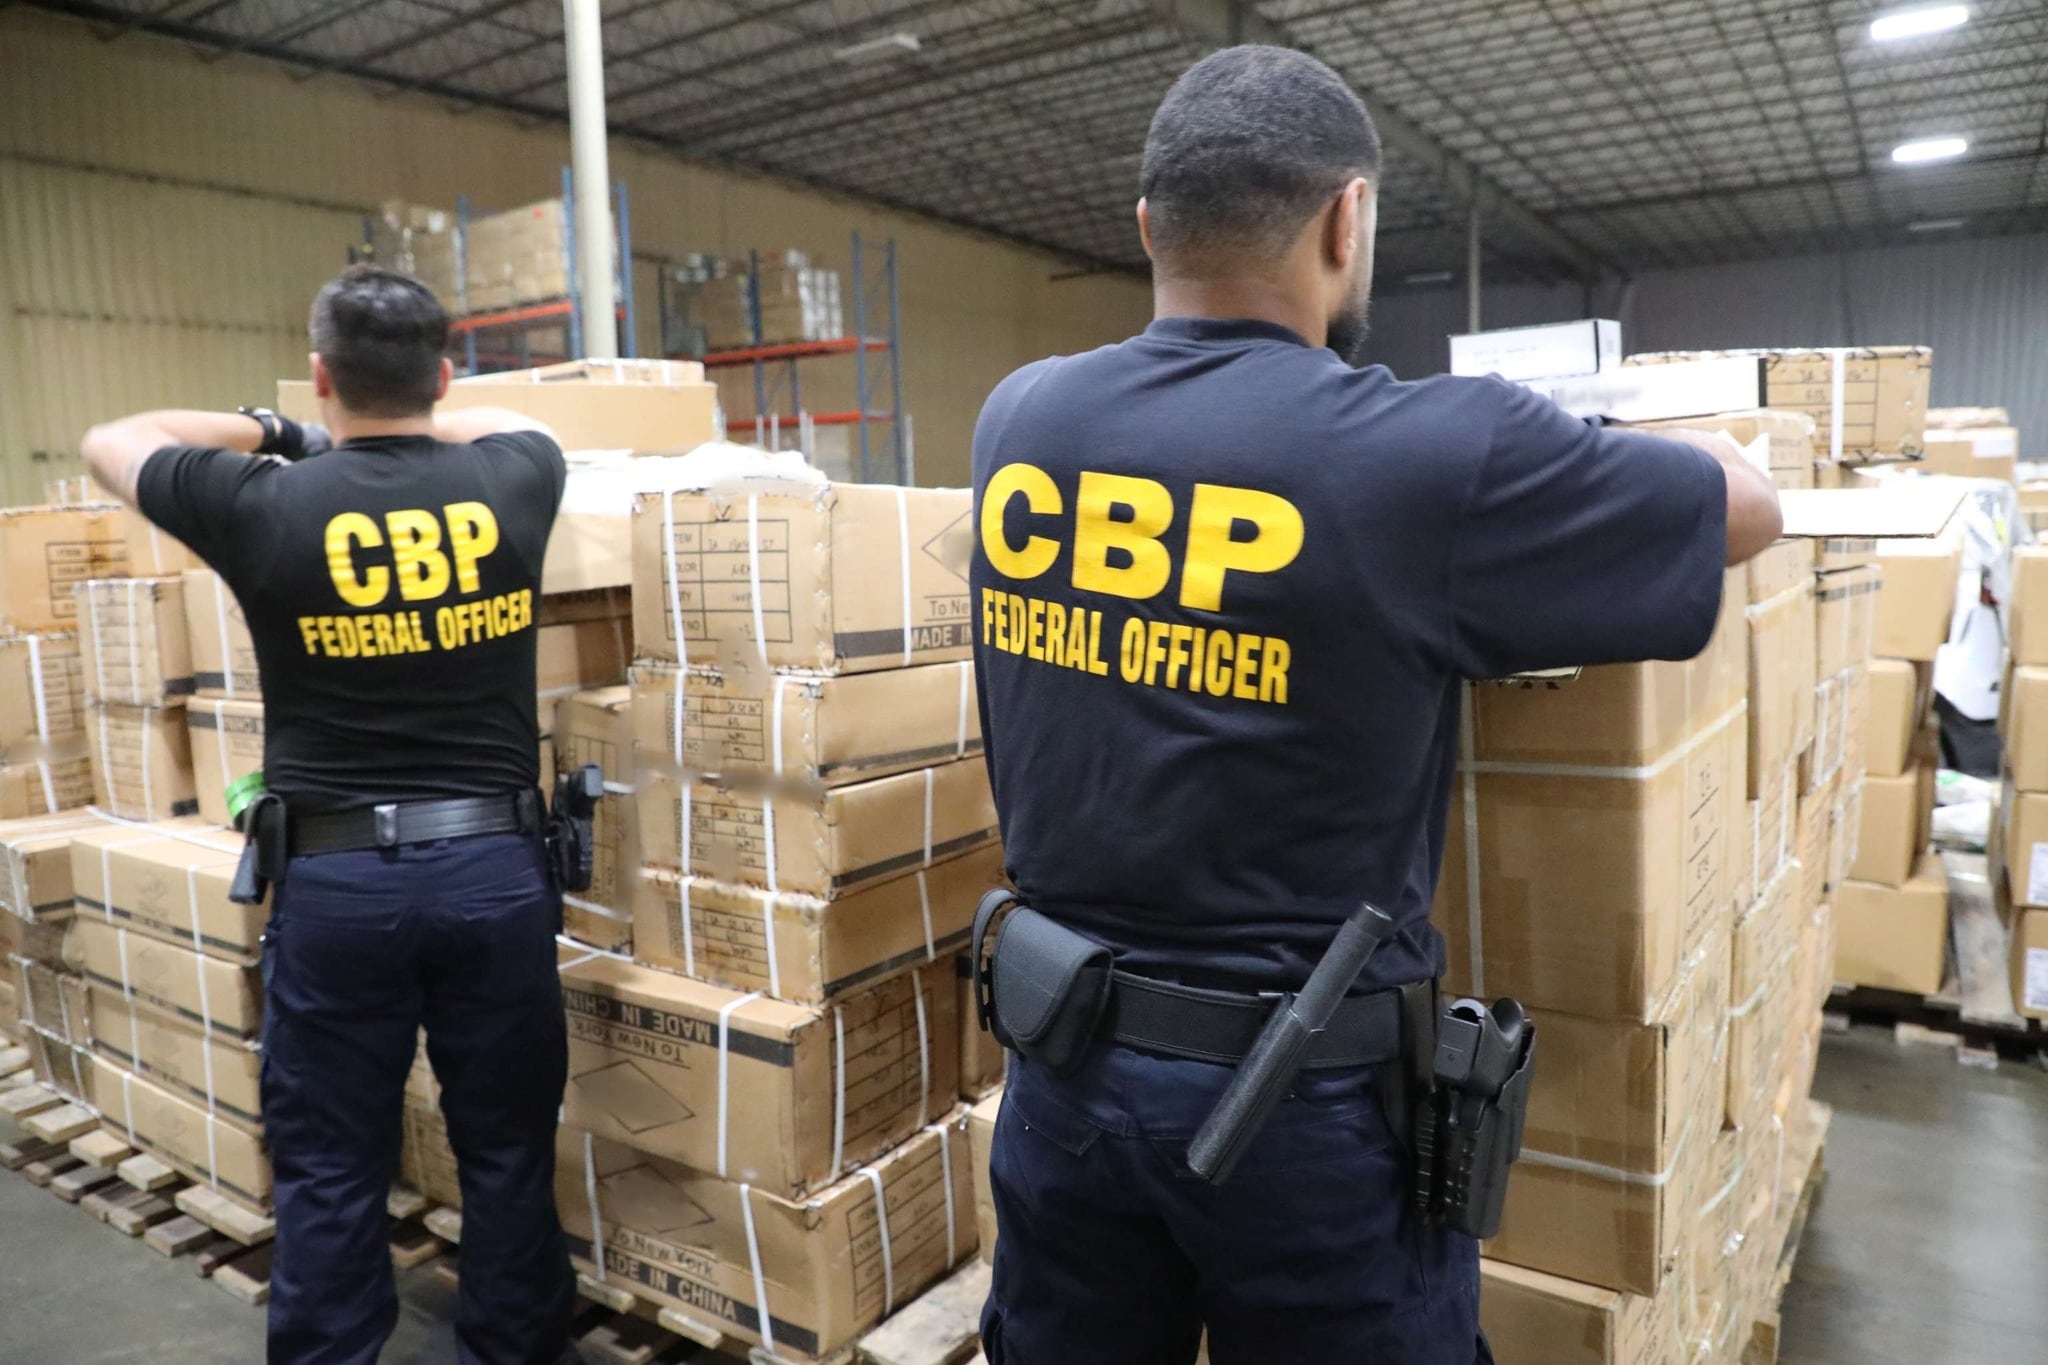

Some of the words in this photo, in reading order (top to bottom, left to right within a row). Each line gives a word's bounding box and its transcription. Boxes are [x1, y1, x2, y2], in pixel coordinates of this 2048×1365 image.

[981, 462, 1305, 612] CBP
[324, 501, 499, 608] CBP
[929, 600, 947, 616] To
[951, 599, 969, 616] Ne
[297, 611, 431, 658] FEDERAL
[436, 588, 532, 650] OFFICER
[982, 587, 1109, 676] FEDERAL
[1120, 616, 1291, 704] OFFICER
[564, 989, 610, 1017] CHIN
[621, 1003, 641, 1027] IN
[574, 1018, 612, 1042] York
[653, 1012, 711, 1044] MADE
[618, 1033, 656, 1056] New
[662, 1046, 685, 1063] To
[611, 1223, 630, 1246] To
[650, 1267, 668, 1291] IN
[677, 1279, 737, 1322] CHINA
